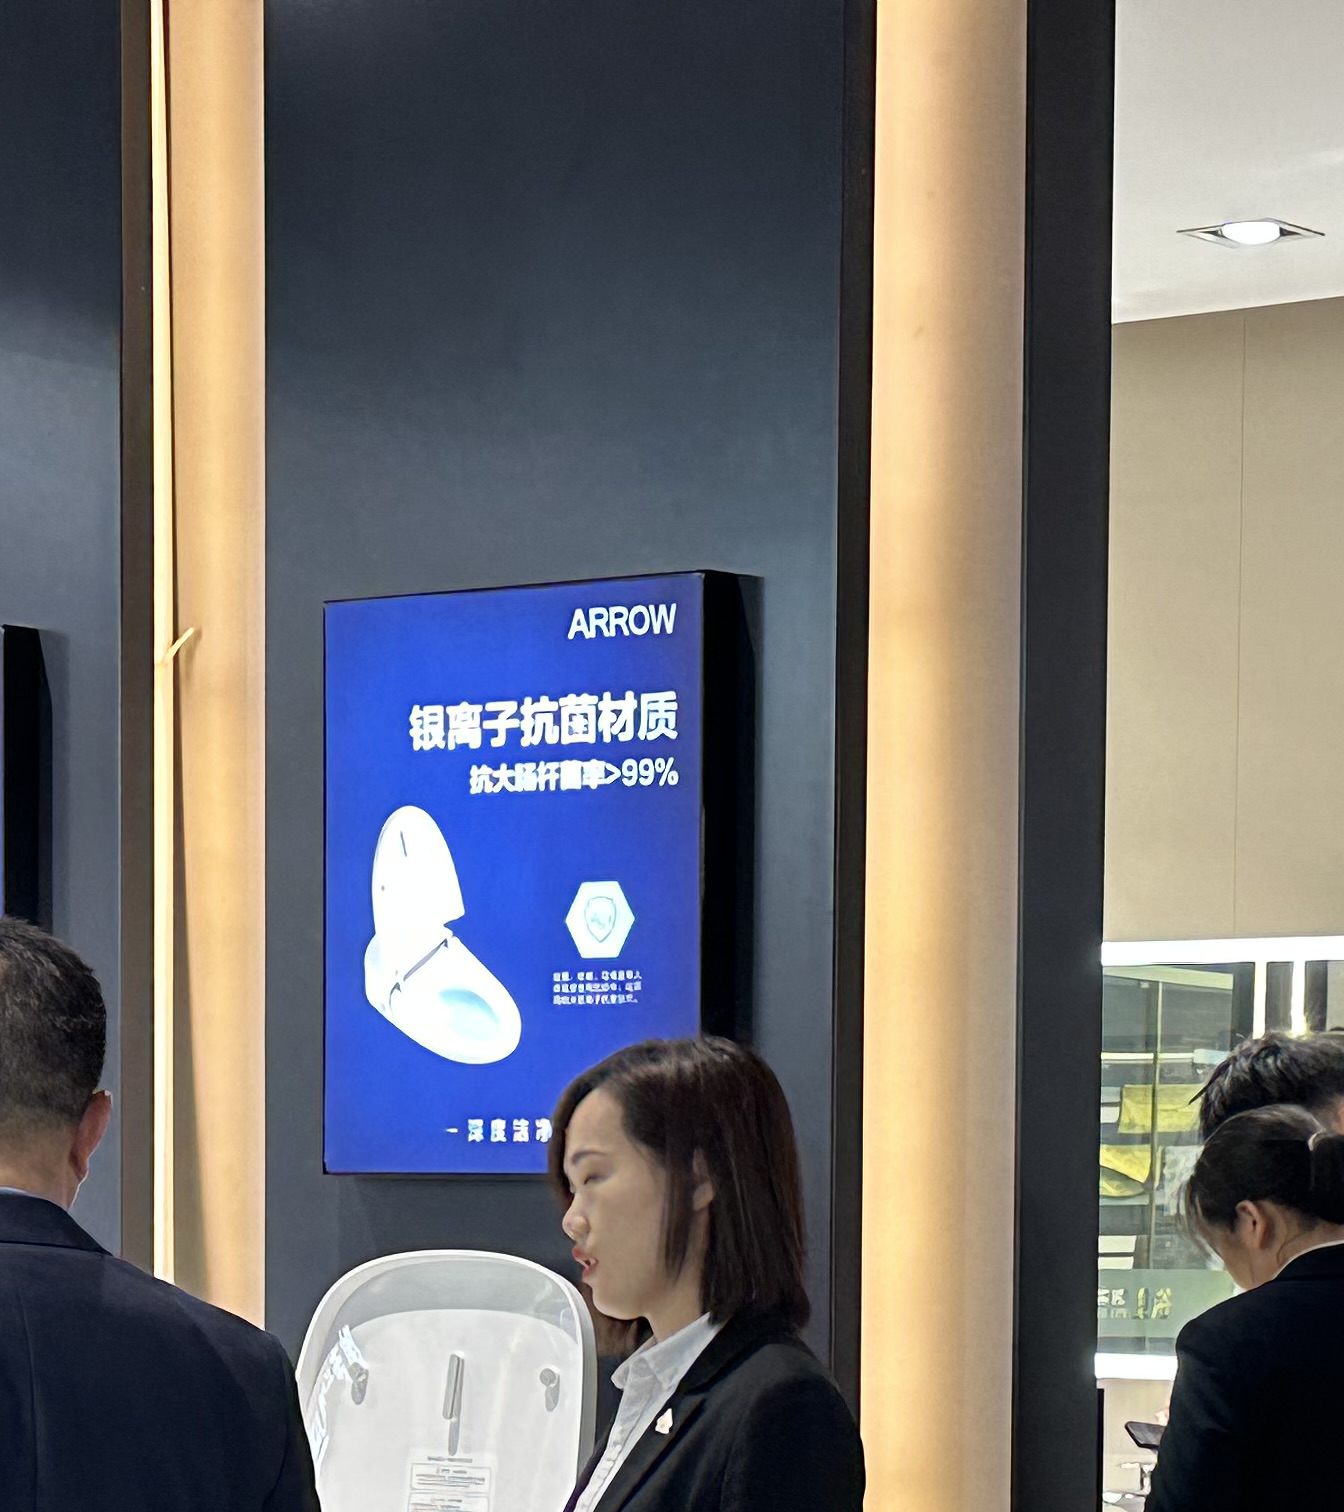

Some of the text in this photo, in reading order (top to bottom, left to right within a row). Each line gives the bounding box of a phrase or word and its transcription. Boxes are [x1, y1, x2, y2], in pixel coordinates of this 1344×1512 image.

[567, 603, 677, 639] ARROW
[409, 691, 678, 750] 银离子抗菌材质
